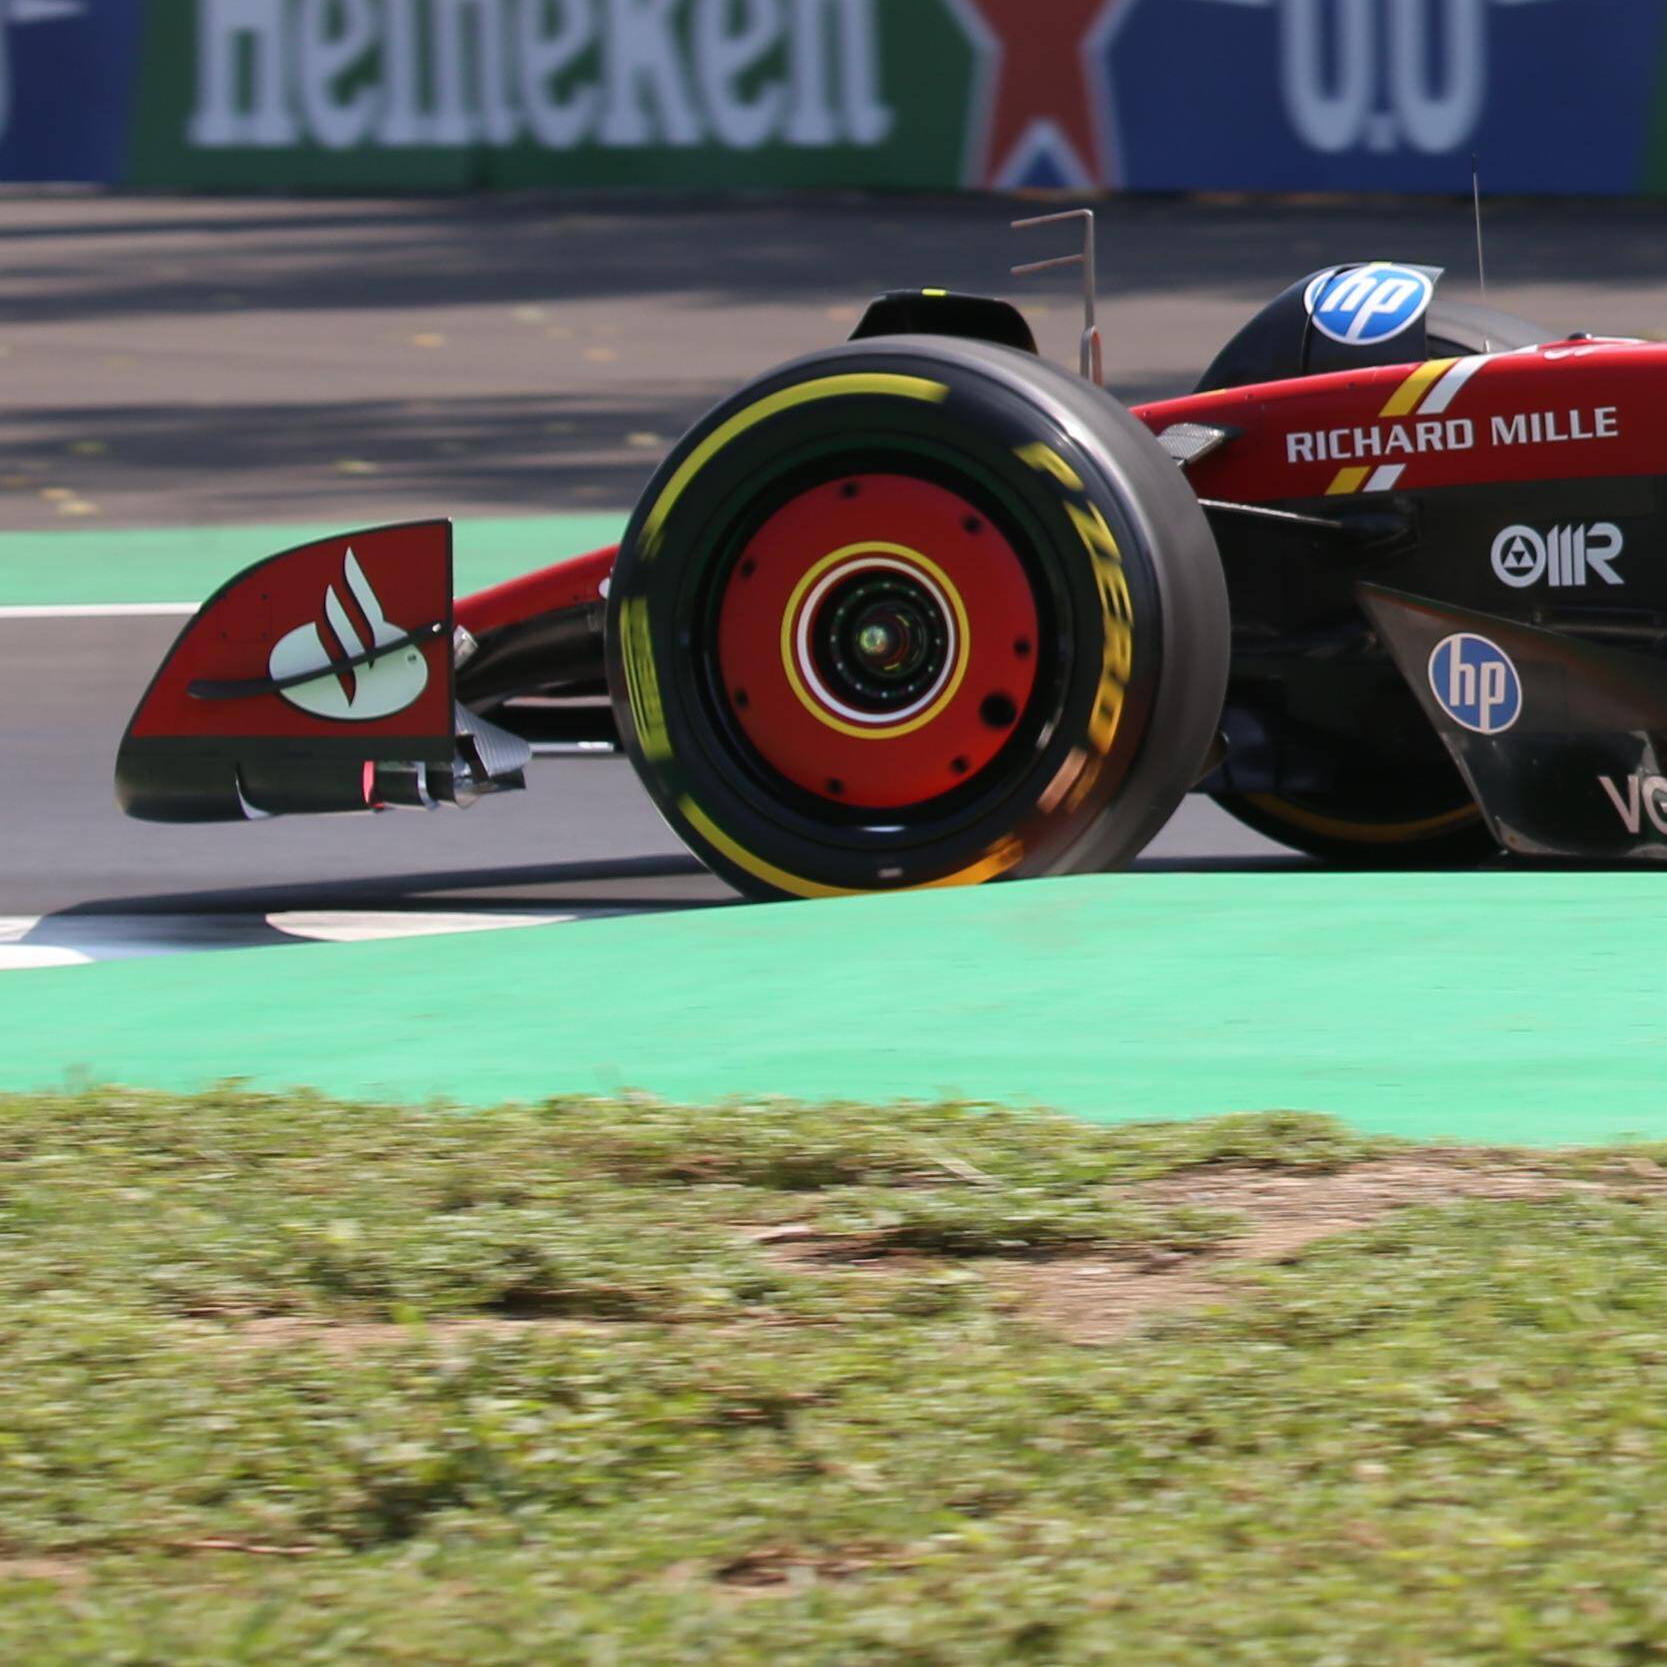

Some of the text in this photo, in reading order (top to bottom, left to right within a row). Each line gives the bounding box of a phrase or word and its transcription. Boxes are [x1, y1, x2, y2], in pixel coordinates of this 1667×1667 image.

[1319, 265, 1419, 343] hp
[1286, 406, 1619, 464] RICHARD MILLE
[1449, 636, 1505, 733] hp
